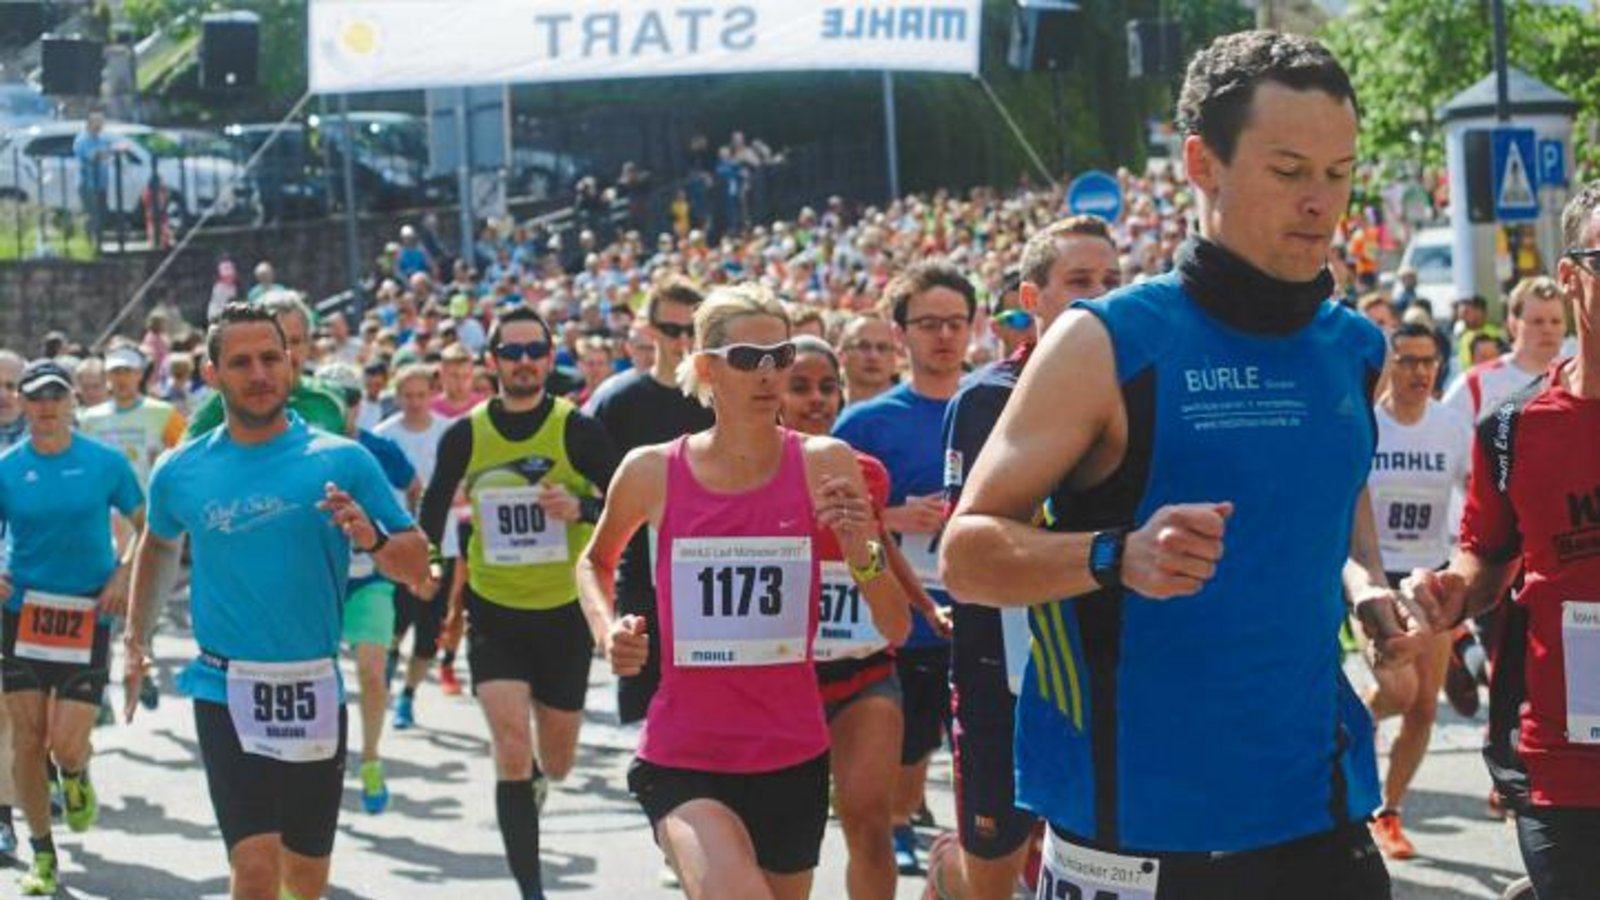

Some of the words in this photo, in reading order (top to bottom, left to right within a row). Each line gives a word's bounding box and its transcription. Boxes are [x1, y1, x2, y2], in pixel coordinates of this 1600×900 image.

[1543, 143, 1558, 179] P
[1374, 451, 1446, 472] MAHLE
[498, 503, 546, 536] 900
[1388, 502, 1432, 531] 899
[697, 565, 784, 617] 1173
[32, 605, 84, 639] 1302
[691, 651, 735, 662] MAHLE
[253, 681, 317, 722] 995
